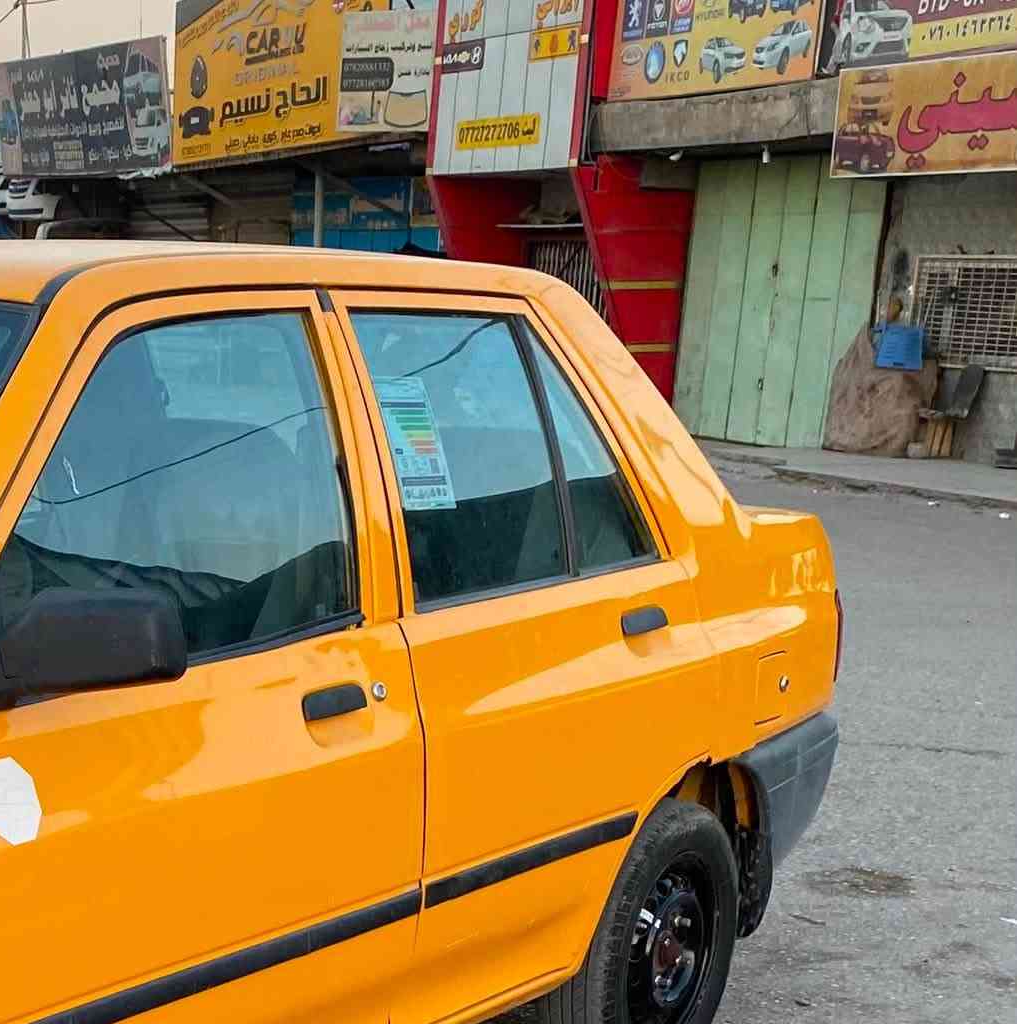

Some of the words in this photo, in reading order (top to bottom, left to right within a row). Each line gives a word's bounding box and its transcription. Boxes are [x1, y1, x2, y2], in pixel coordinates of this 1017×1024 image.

[274, 76, 328, 119] الحاج
[665, 72, 690, 84] IKCO
[219, 87, 271, 128] نسيم
